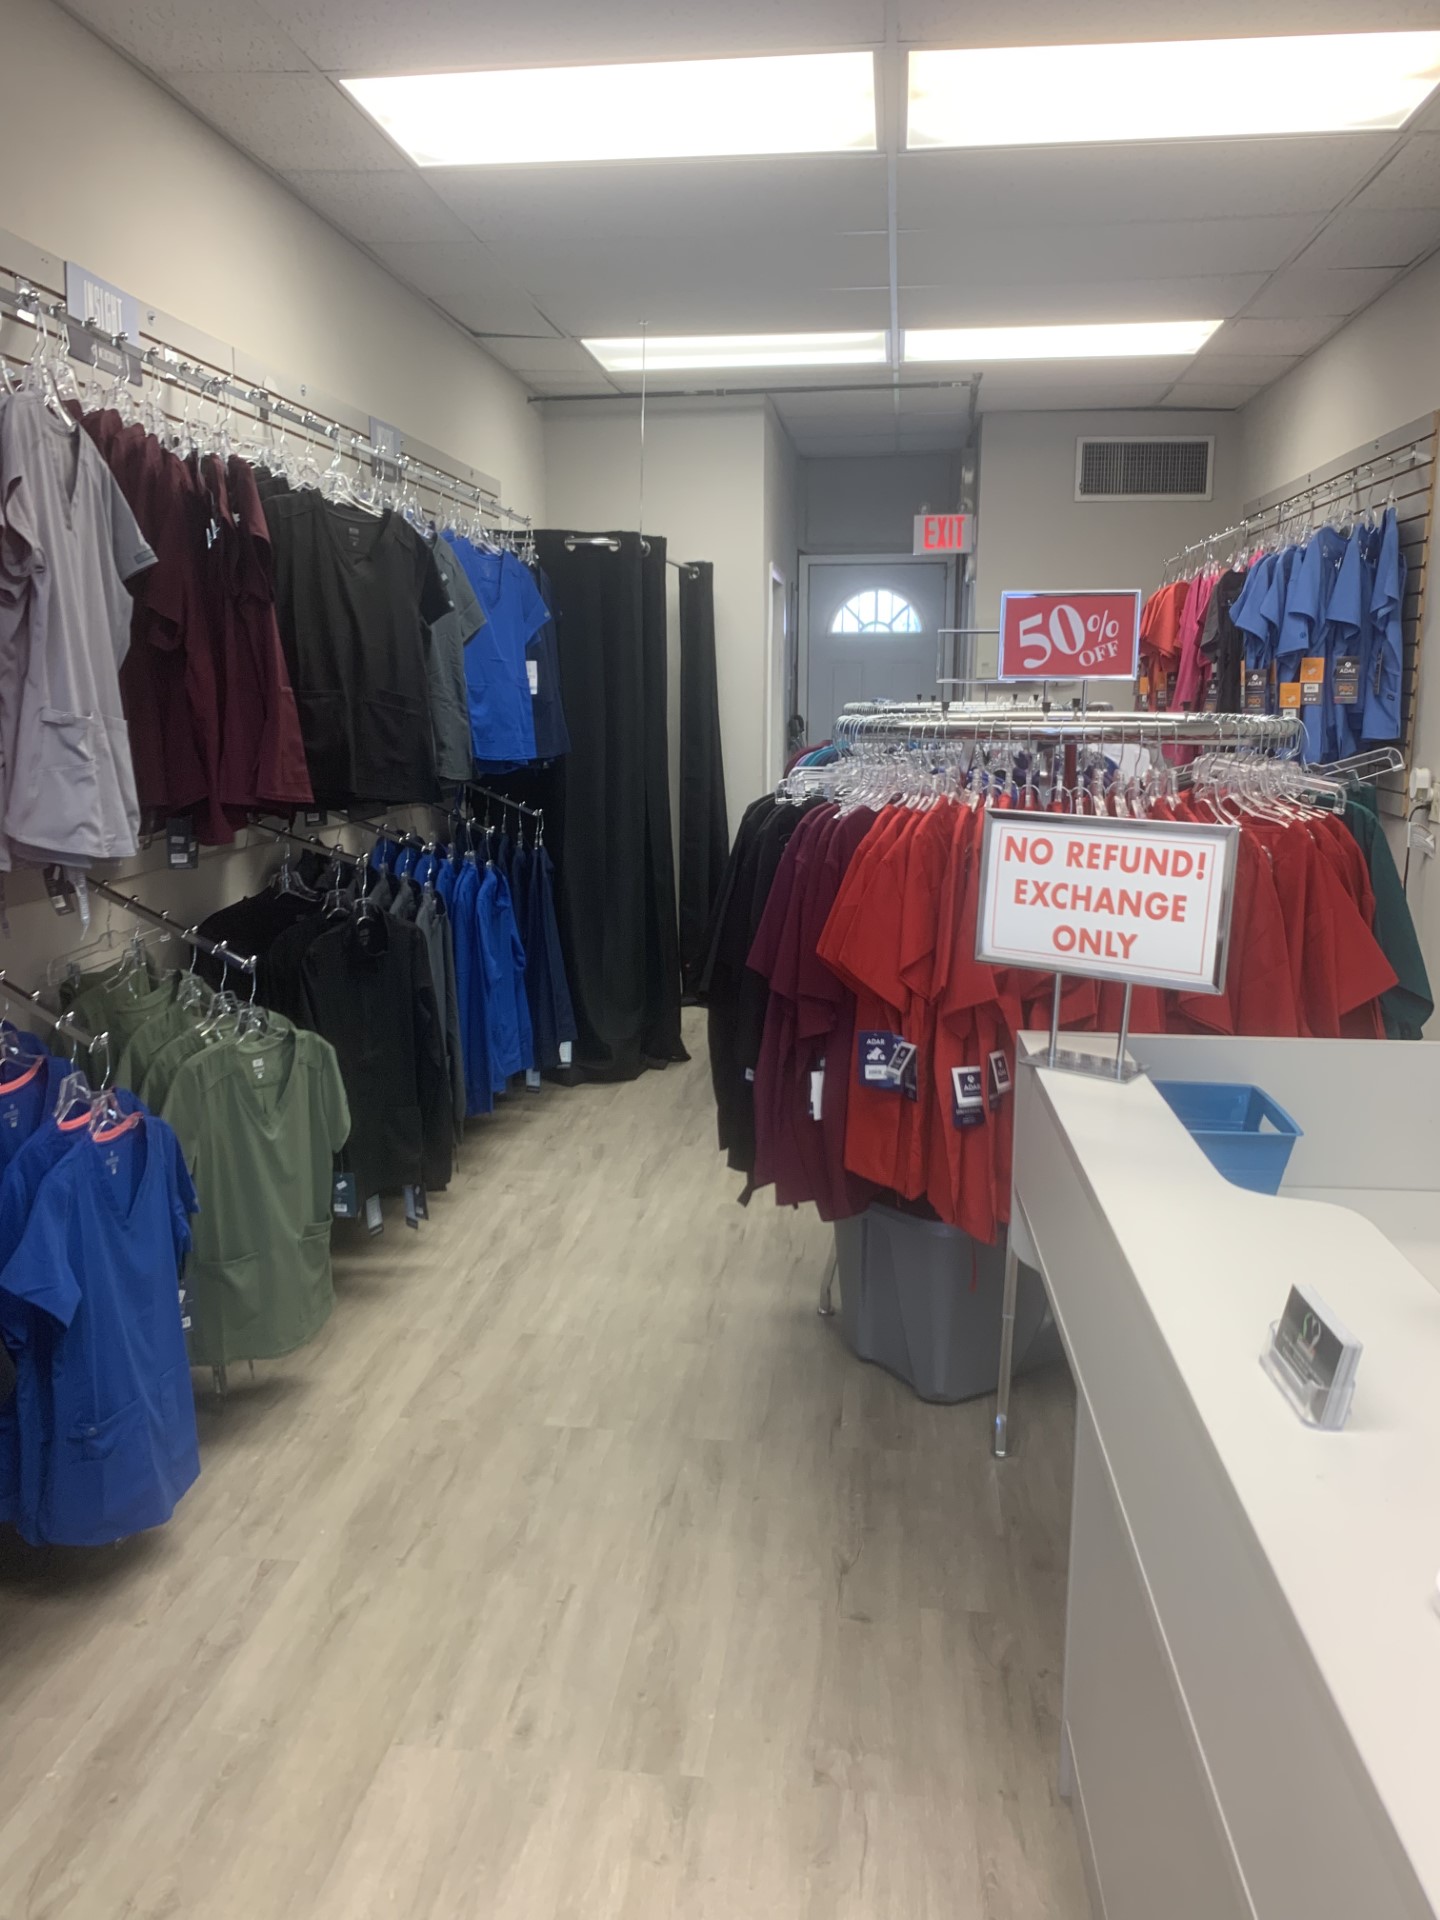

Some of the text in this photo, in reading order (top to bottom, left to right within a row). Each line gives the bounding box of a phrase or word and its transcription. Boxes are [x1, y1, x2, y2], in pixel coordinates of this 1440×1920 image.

[924, 516, 965, 548] EXIT
[1019, 604, 1119, 669] 50%
[1079, 640, 1119, 667] OFF
[1004, 836, 1206, 880] NO REFUND!
[1014, 879, 1187, 922] EXCHANGE
[1052, 925, 1138, 959] ONLY
